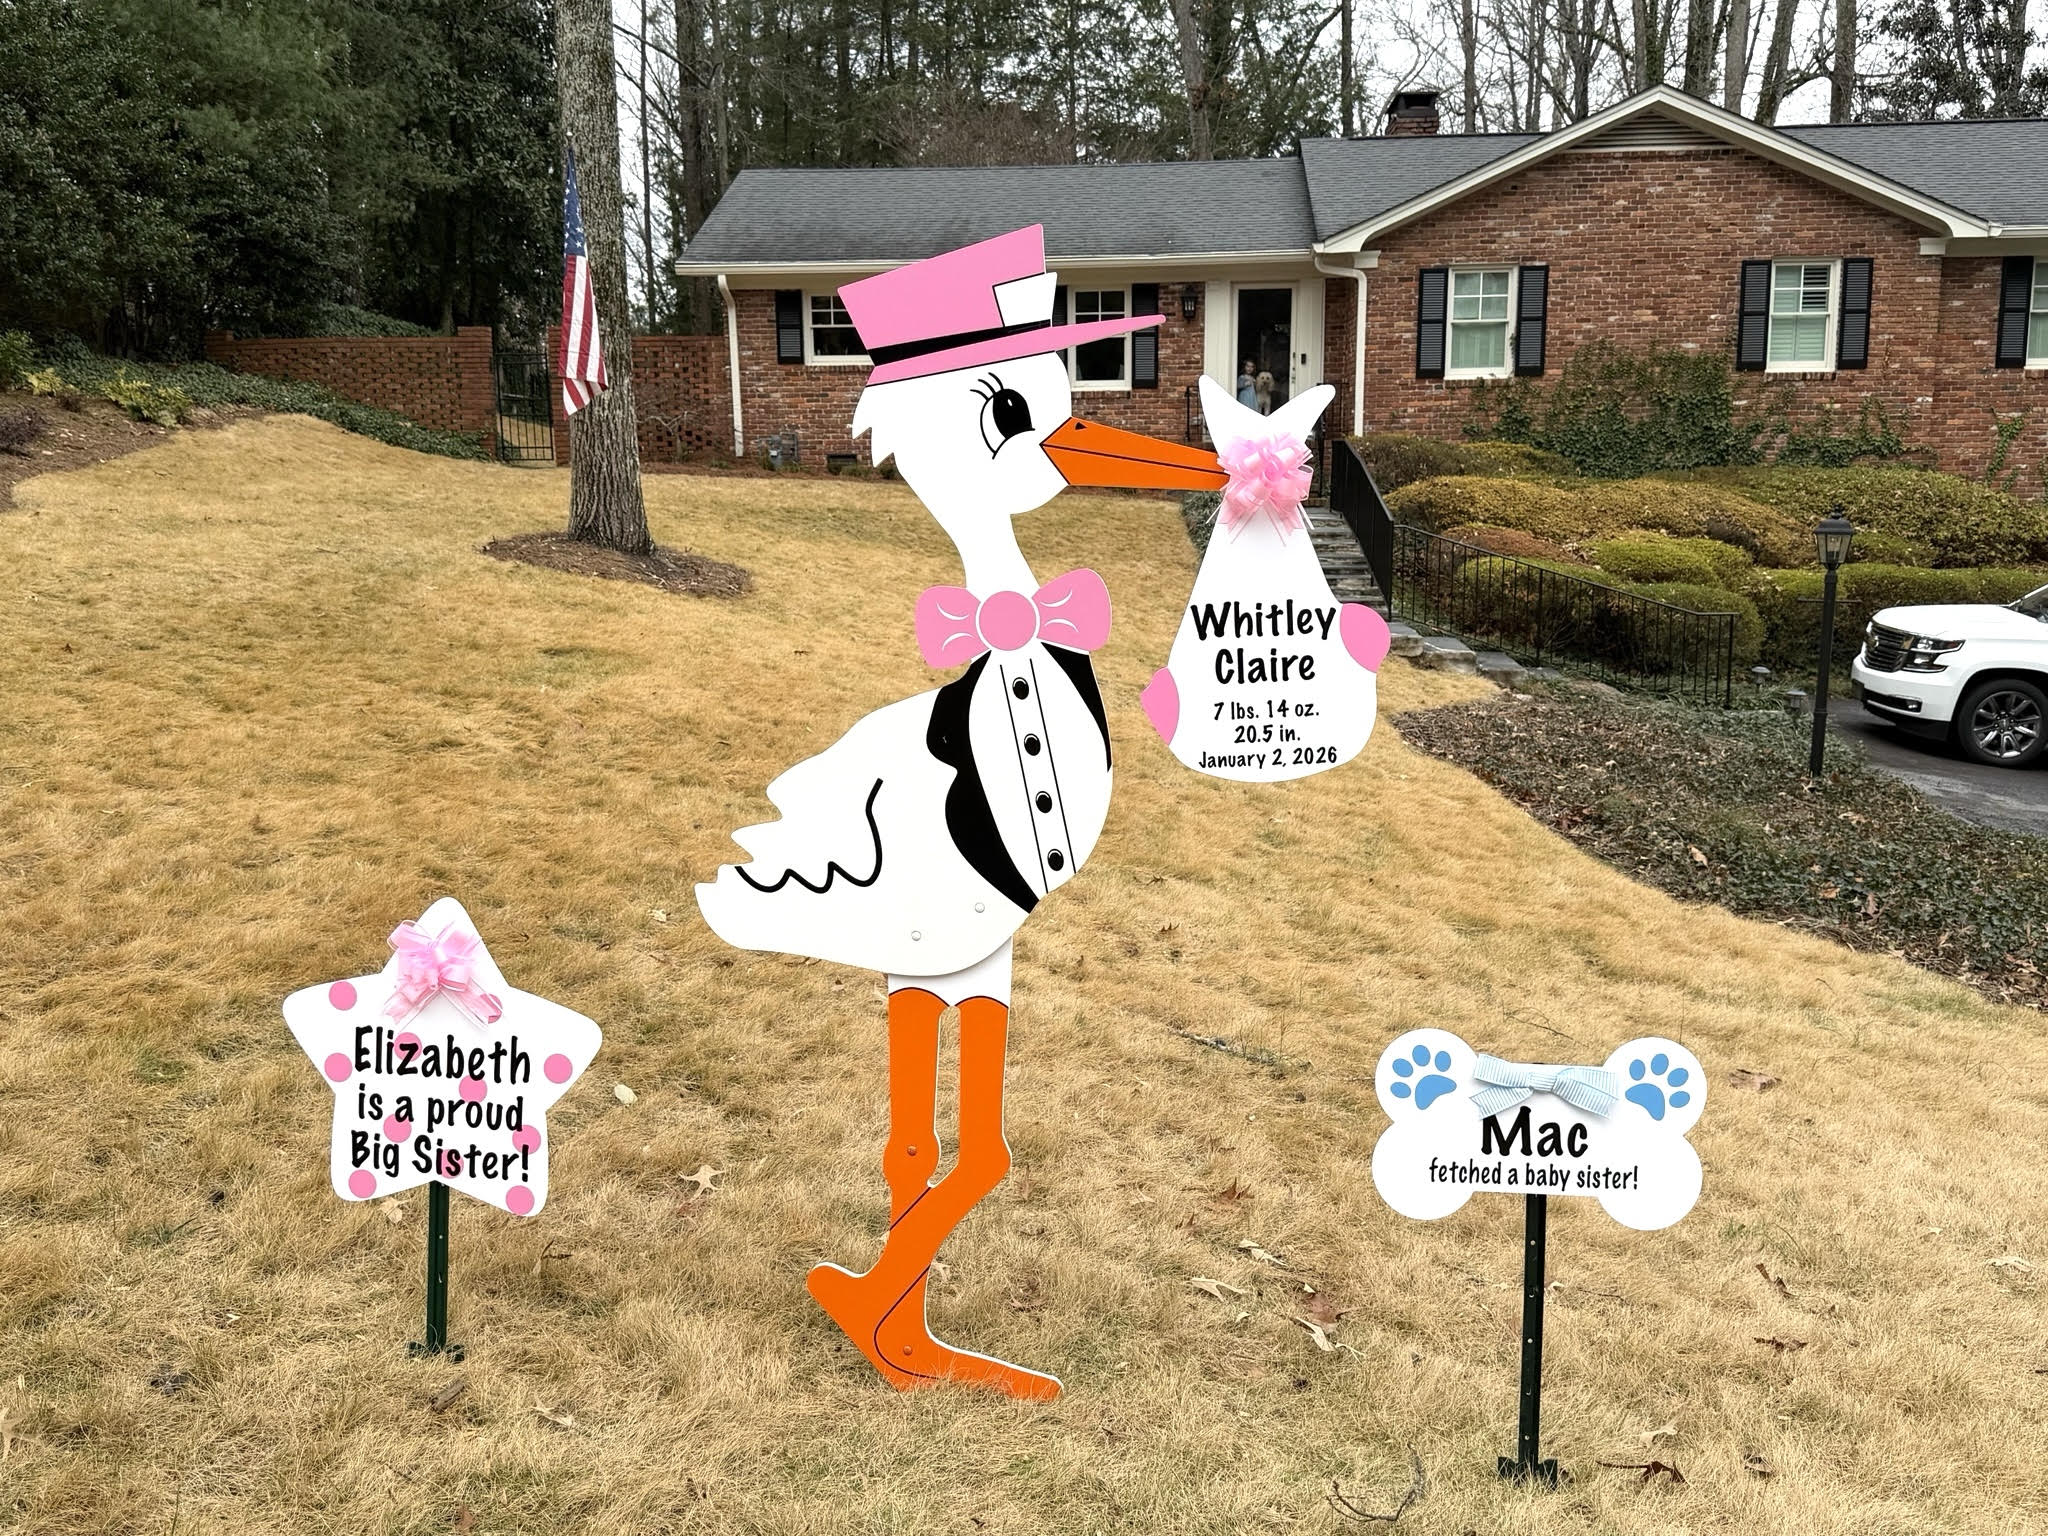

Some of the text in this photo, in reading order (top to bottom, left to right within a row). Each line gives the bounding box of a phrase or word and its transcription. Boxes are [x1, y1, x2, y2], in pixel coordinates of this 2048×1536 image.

[1191, 599, 1336, 640] Whitley
[1216, 648, 1315, 684] Claire
[1215, 700, 1319, 720] 7 lbs. 14 oz.
[1235, 725, 1300, 743] 20.5 in.
[1199, 747, 1336, 769] January 2, 2026
[355, 1026, 530, 1085] Elizabeth
[359, 1083, 523, 1133] is a proud
[1481, 1106, 1588, 1157] Mac
[351, 1130, 529, 1182] Big Sister!
[1429, 1157, 1637, 1191] fetched a baby sister!
